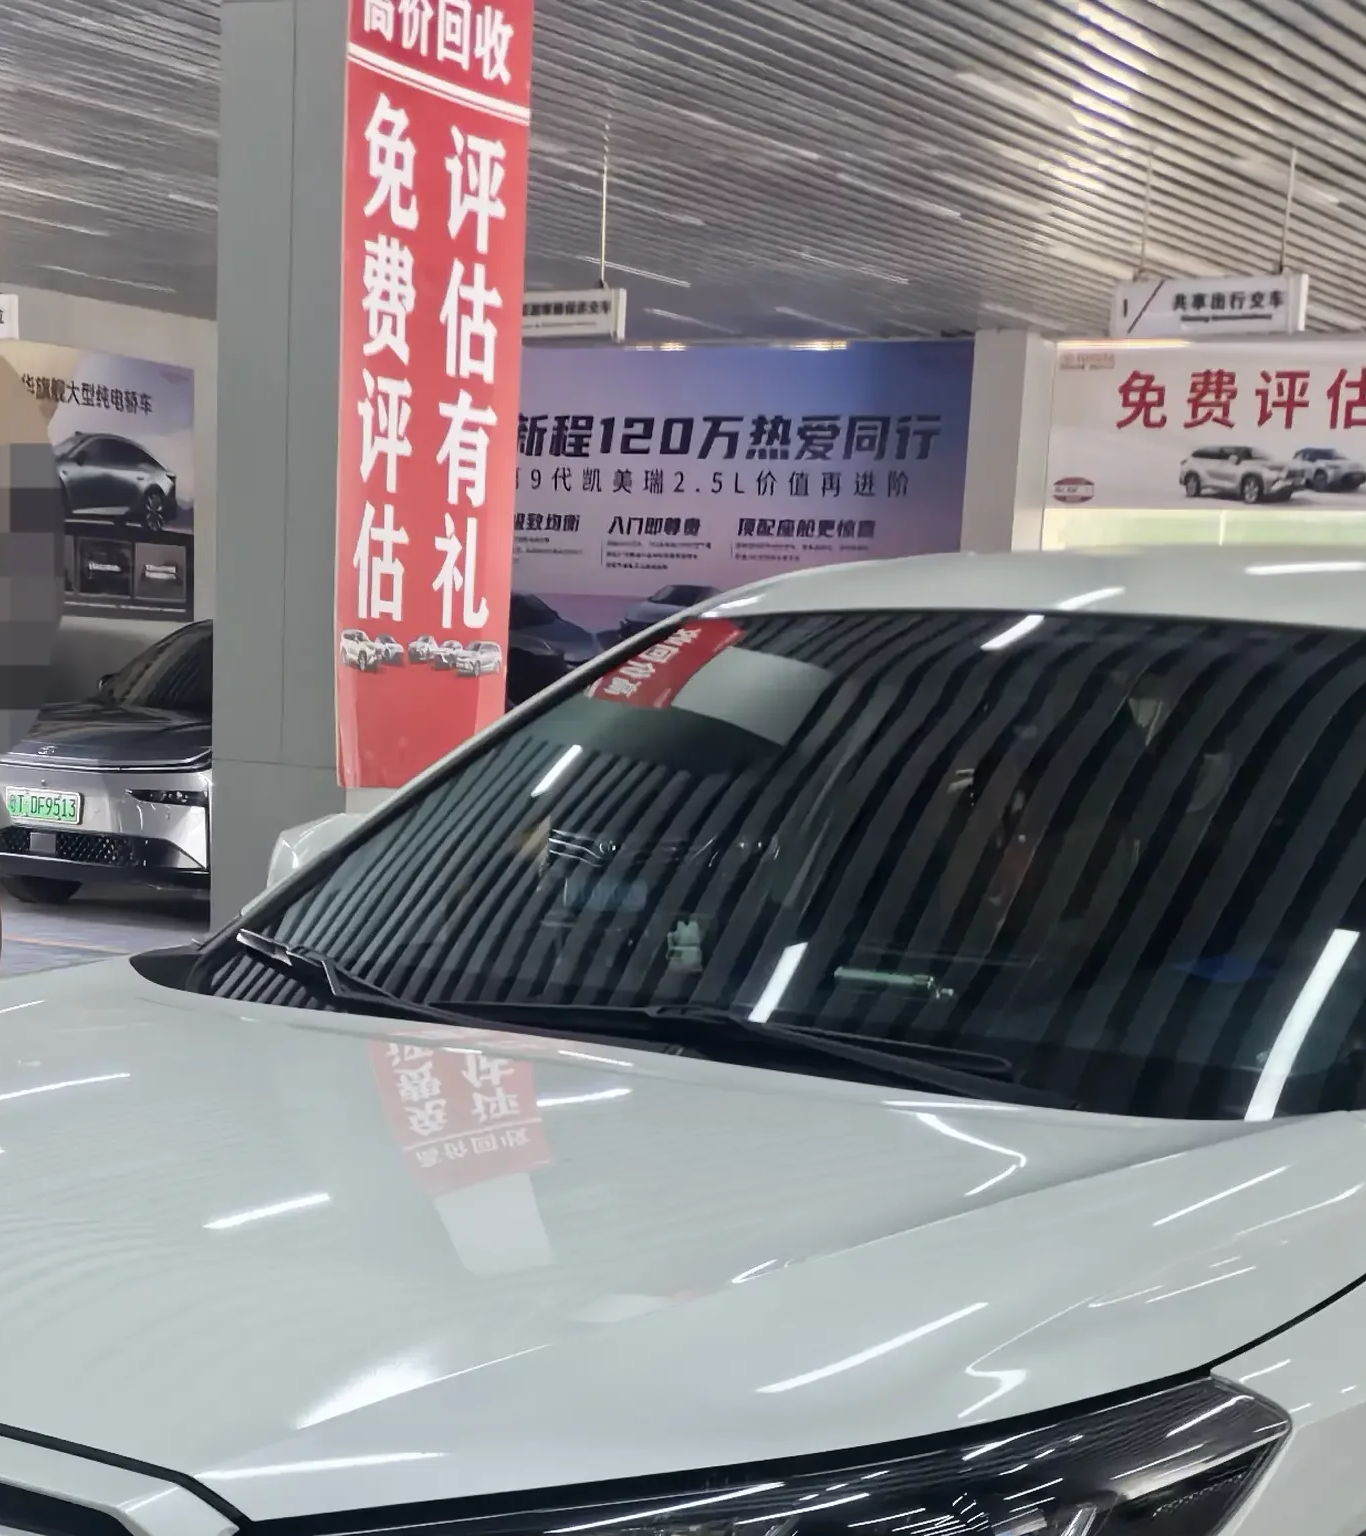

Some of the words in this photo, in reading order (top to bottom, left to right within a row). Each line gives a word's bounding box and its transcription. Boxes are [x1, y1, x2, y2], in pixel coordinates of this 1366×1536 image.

[363, 0, 514, 85] 高价回收
[352, 92, 419, 622] 免费评估
[431, 124, 507, 629] 评估有礼
[515, 466, 909, 498] 9代凯美瑞2.5L价值再进阶
